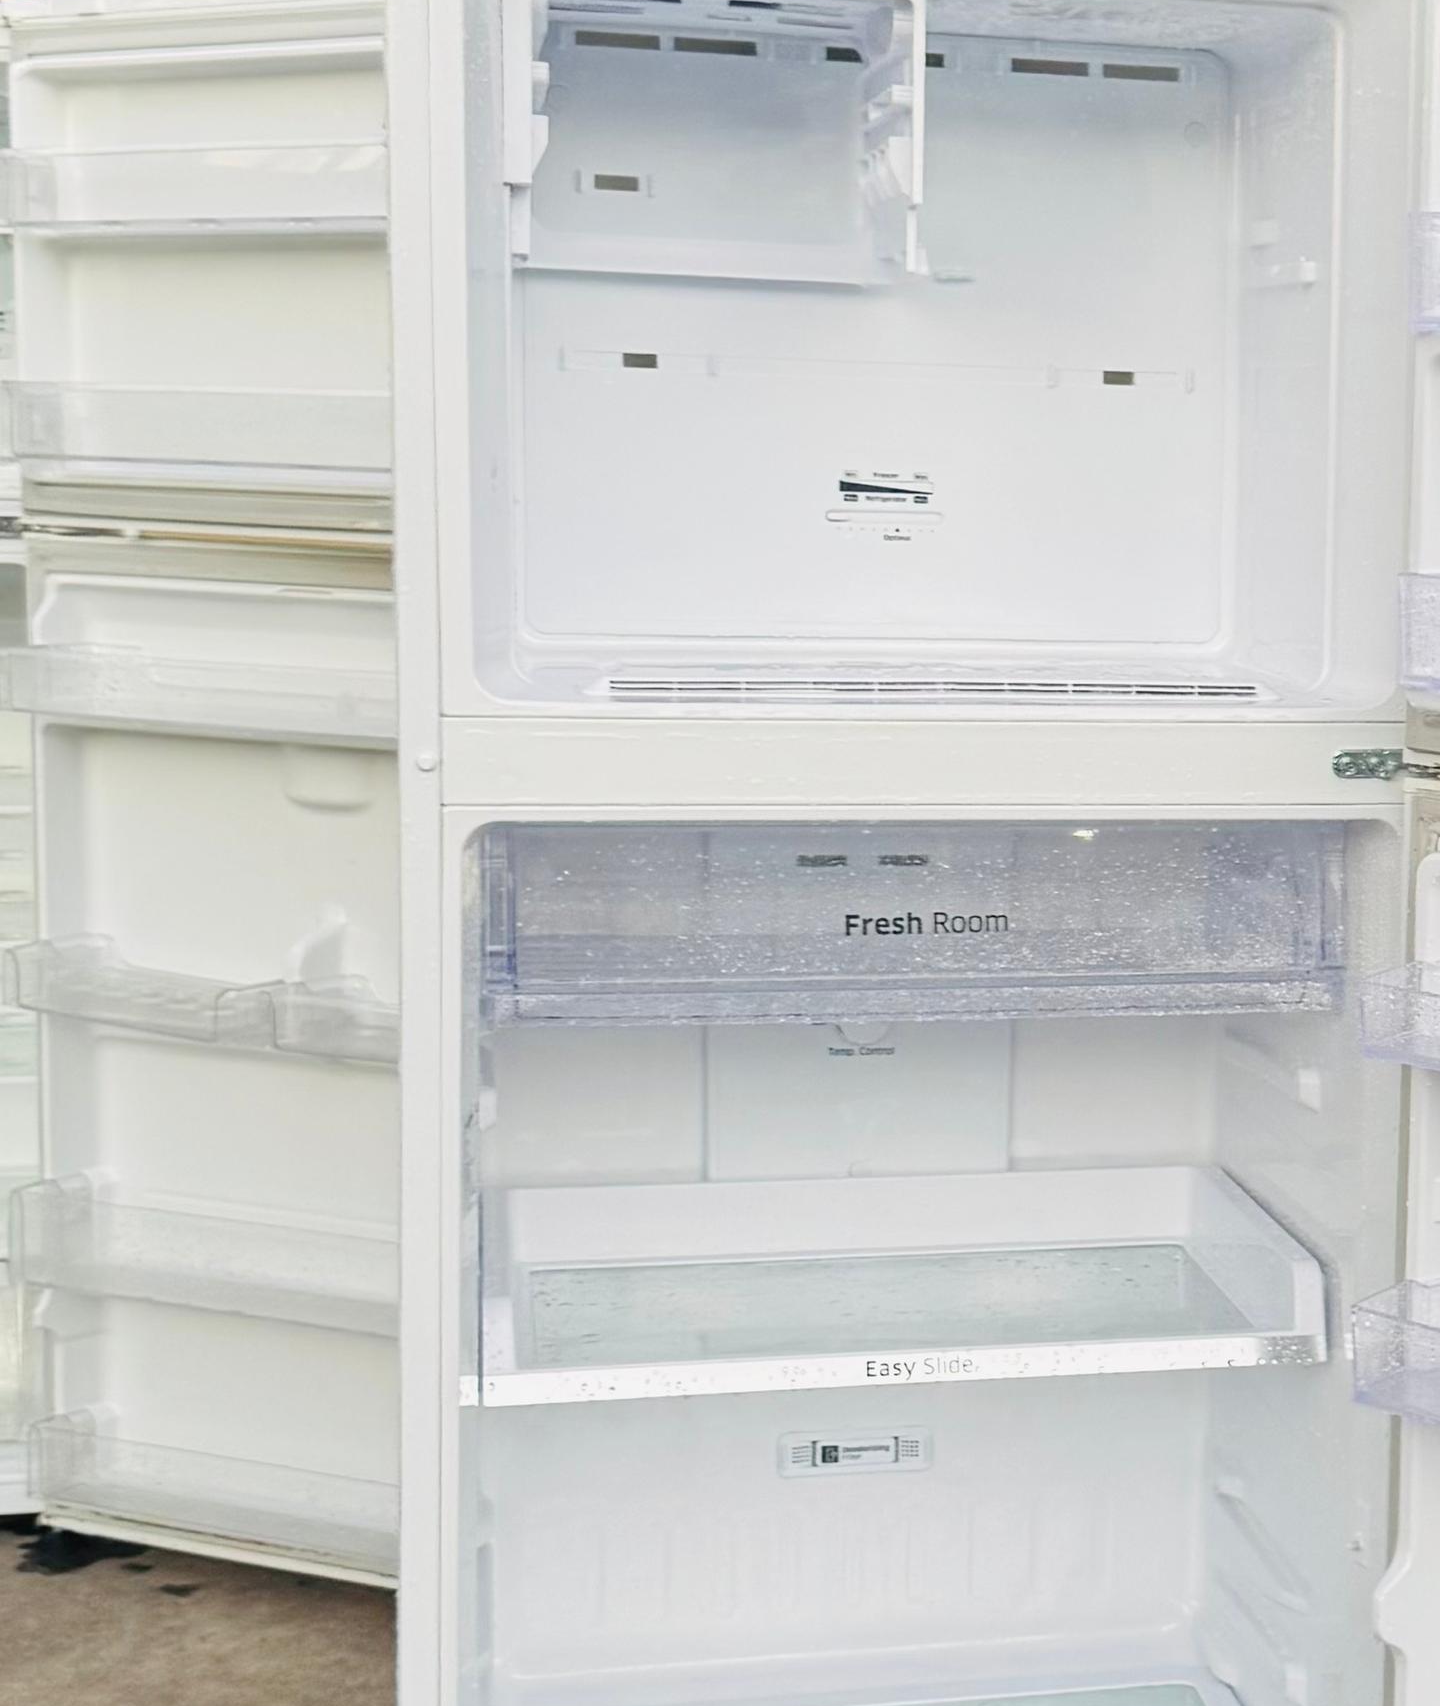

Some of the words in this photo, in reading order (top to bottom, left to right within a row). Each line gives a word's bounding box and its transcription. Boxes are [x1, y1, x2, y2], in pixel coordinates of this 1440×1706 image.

[844, 912, 923, 936] Fresh
[933, 912, 1009, 934] Room
[866, 1360, 916, 1381] Easy
[923, 1356, 974, 1375] Slide
